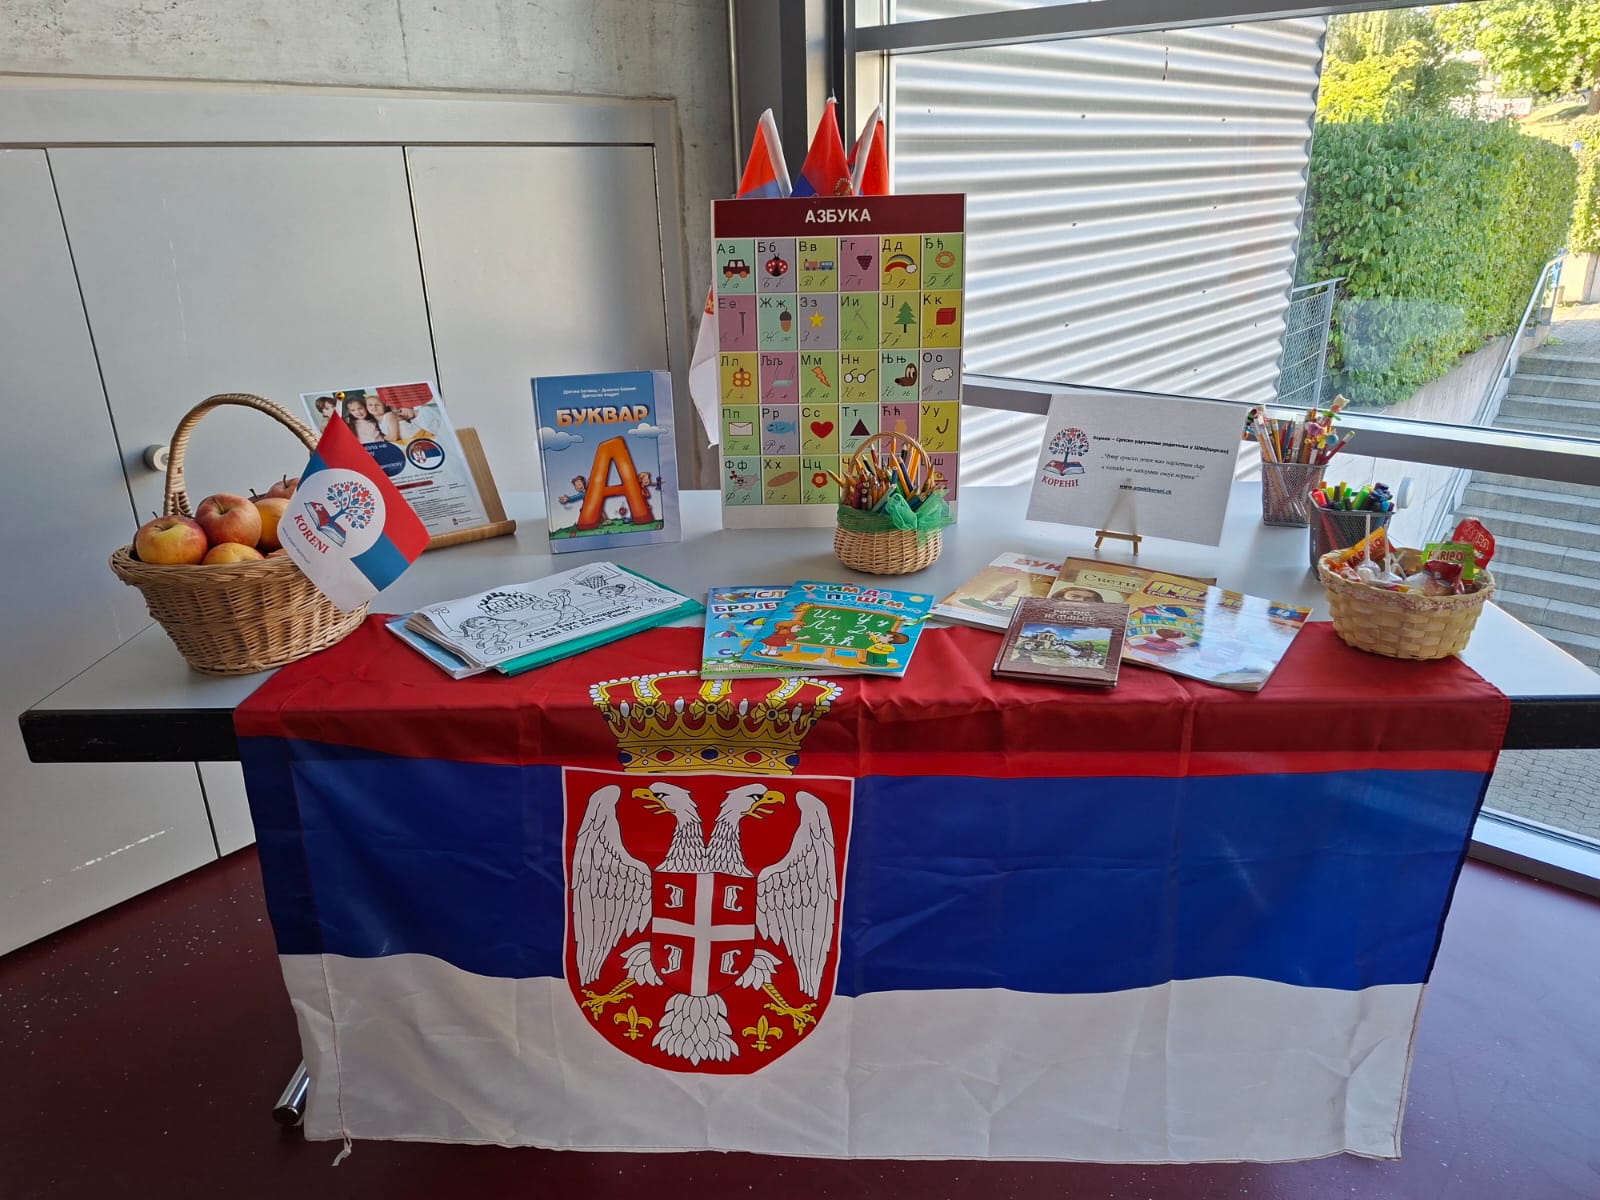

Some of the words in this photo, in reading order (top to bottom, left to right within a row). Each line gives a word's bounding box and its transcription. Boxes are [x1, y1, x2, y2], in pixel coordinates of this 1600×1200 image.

[805, 208, 871, 223] АЗБУКА
[557, 406, 649, 427] БУКВАР
[577, 436, 655, 530] А
[1041, 474, 1080, 488] КОРЕНИ
[294, 514, 330, 554] KORENI
